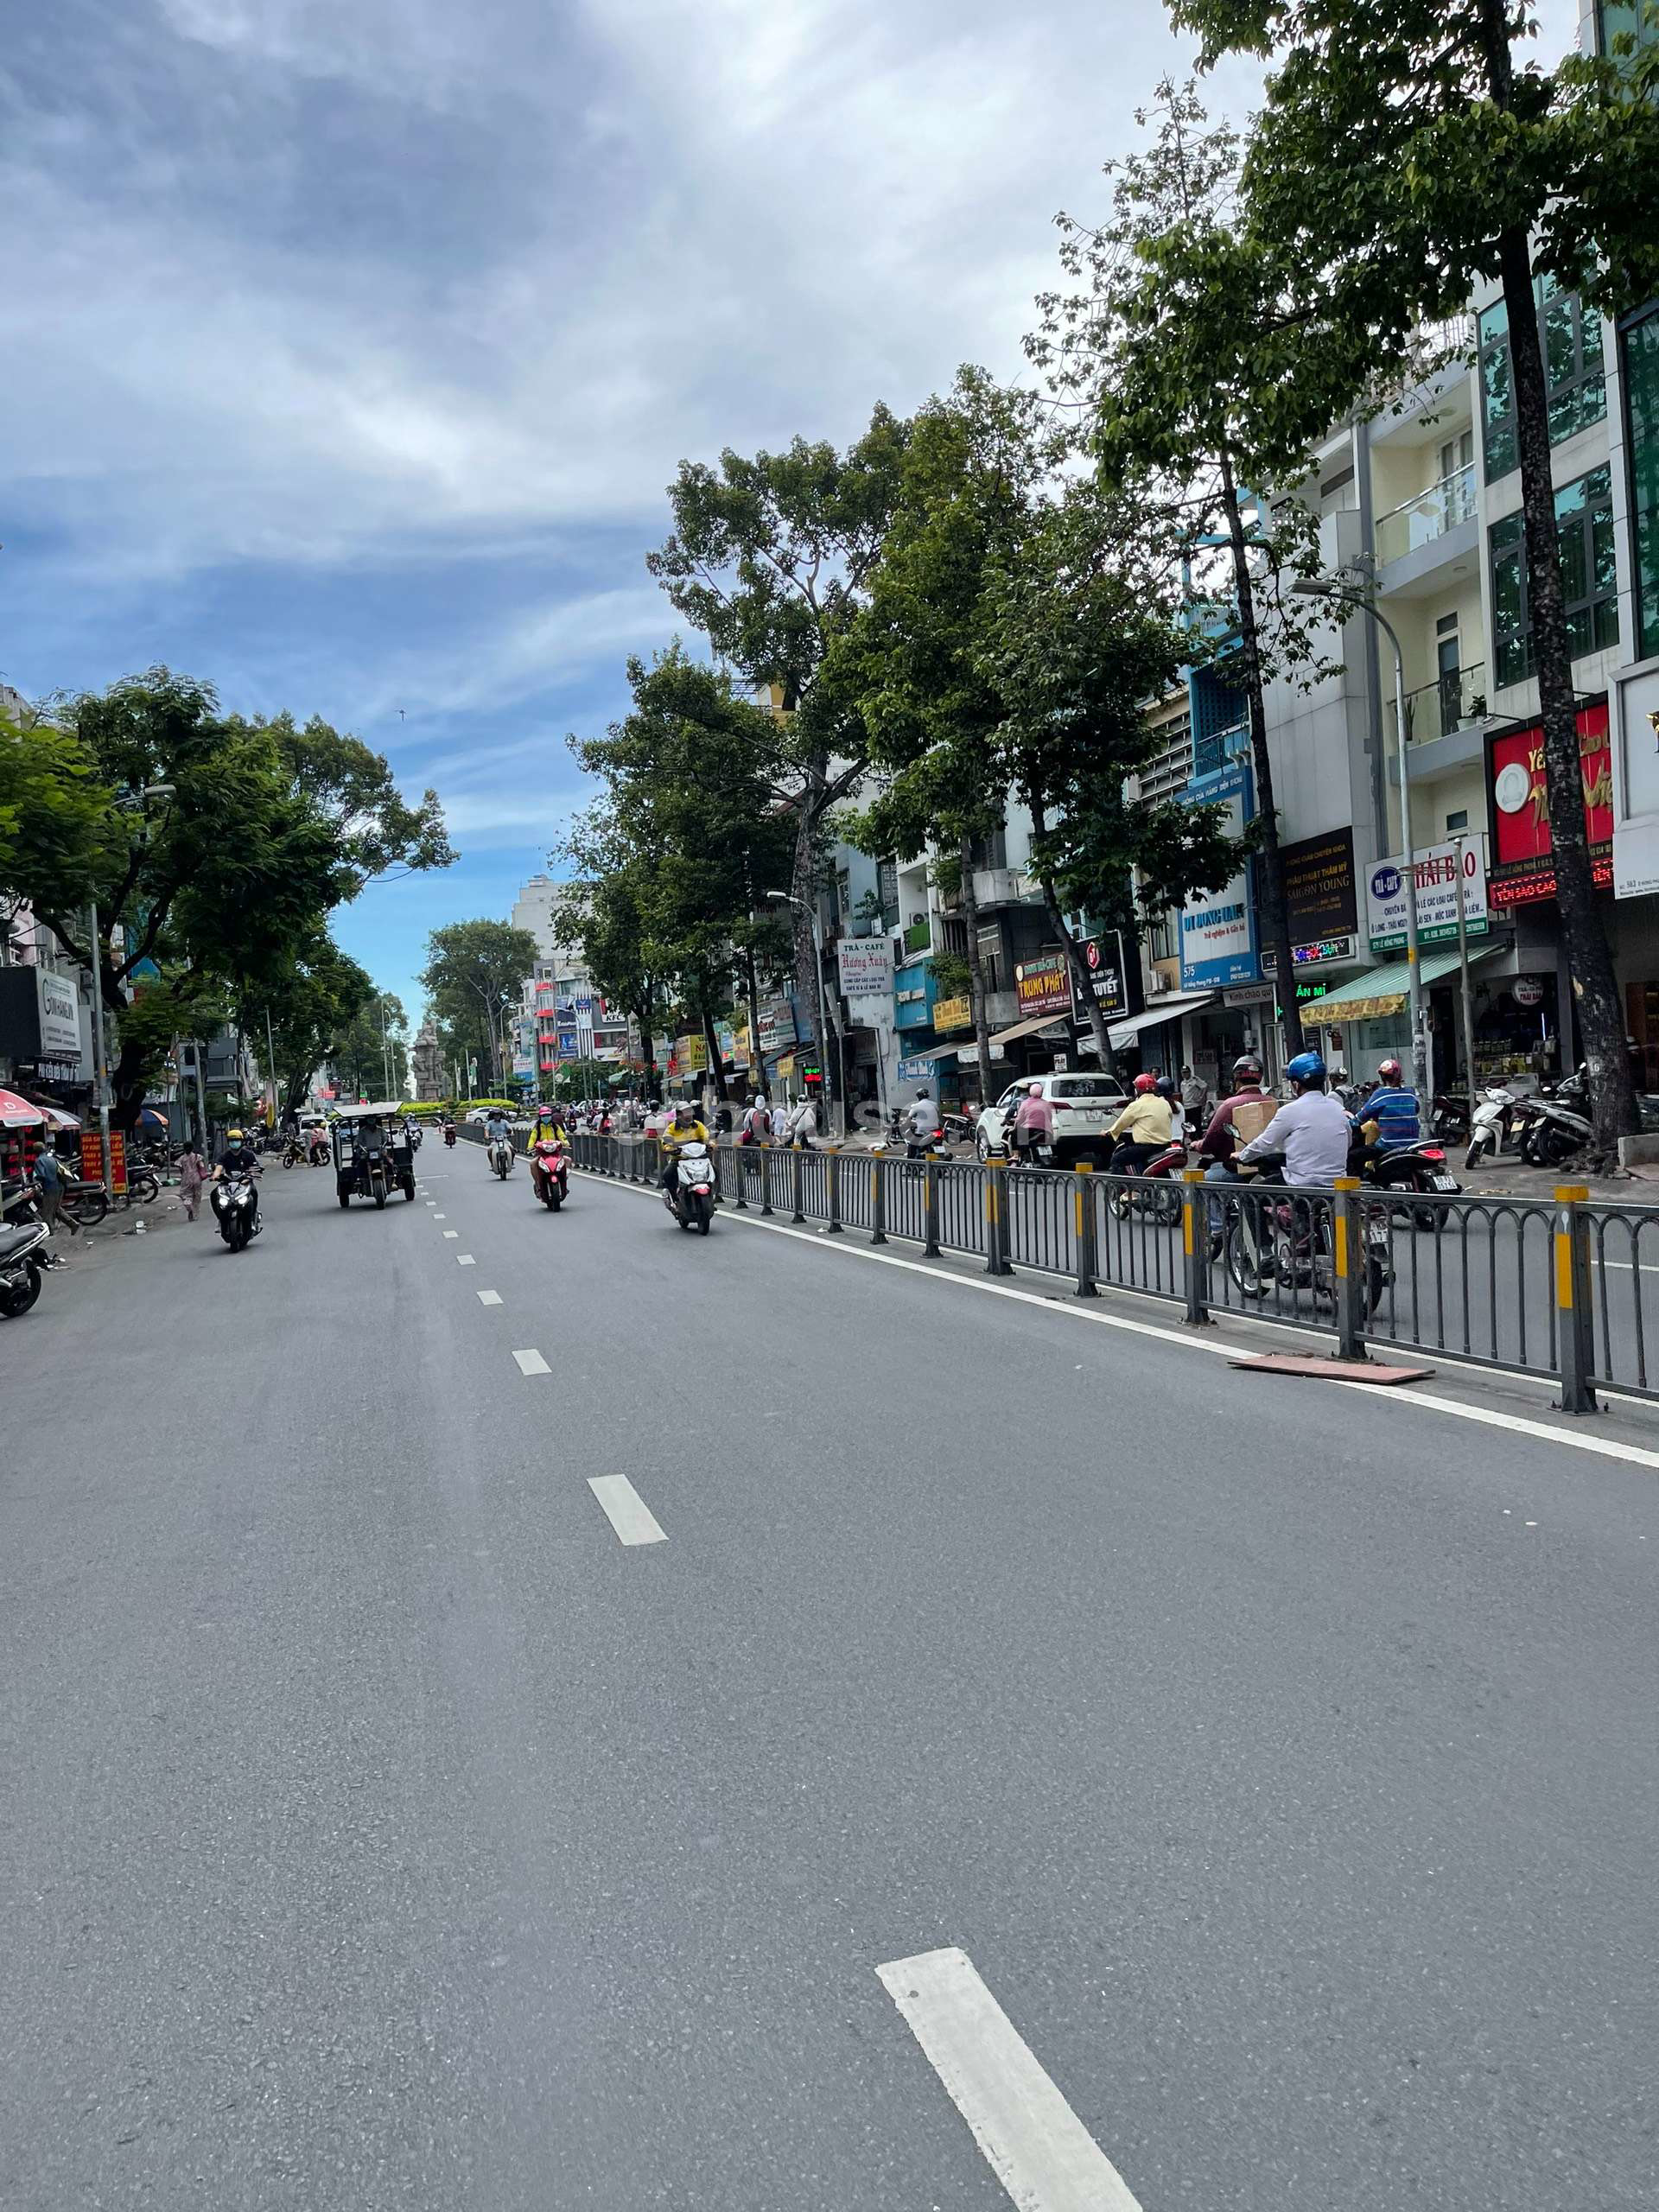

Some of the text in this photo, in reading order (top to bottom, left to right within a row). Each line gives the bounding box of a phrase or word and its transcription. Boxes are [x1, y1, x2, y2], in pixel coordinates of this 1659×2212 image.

[1318, 874, 1350, 893] YOUNG
[843, 943, 859, 951] TRÀ
[1183, 965, 1196, 978] 575
[1092, 976, 1119, 997] TUYẾT
[1296, 984, 1312, 997] ÁN
